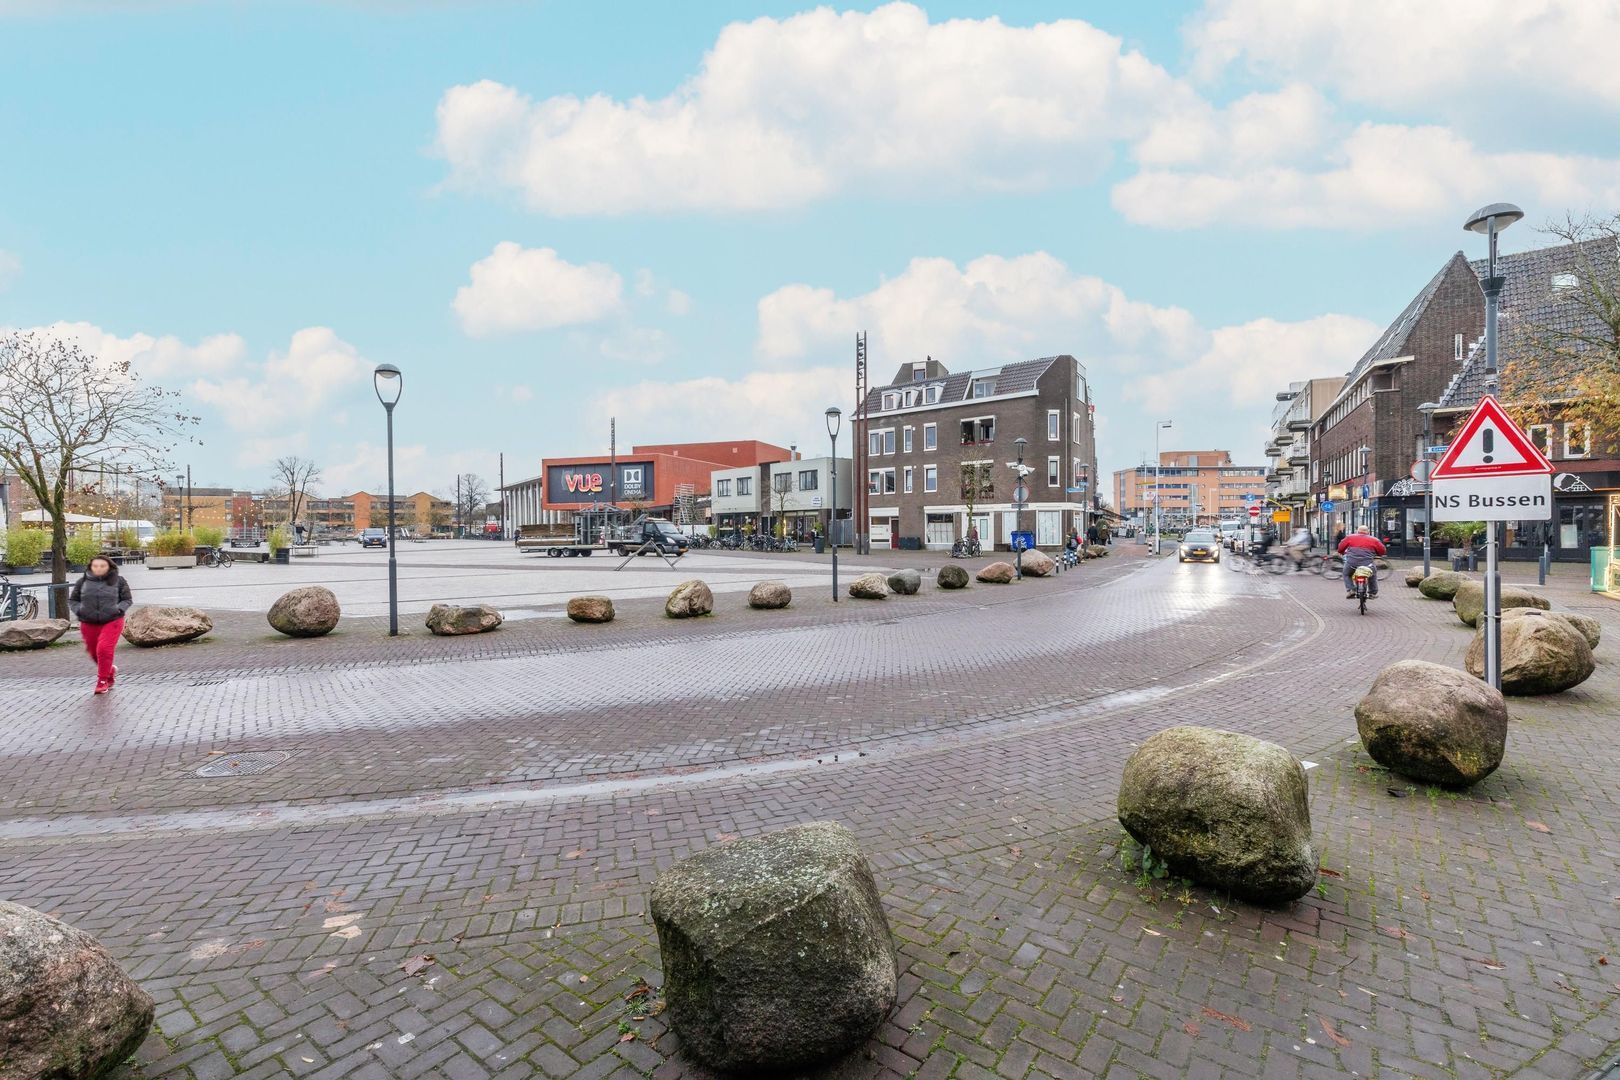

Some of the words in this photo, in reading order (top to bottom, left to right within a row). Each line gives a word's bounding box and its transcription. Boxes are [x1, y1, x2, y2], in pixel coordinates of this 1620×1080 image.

[565, 473, 603, 493] vue
[1435, 495, 1461, 508] NS
[1468, 494, 1546, 508] Bussen
